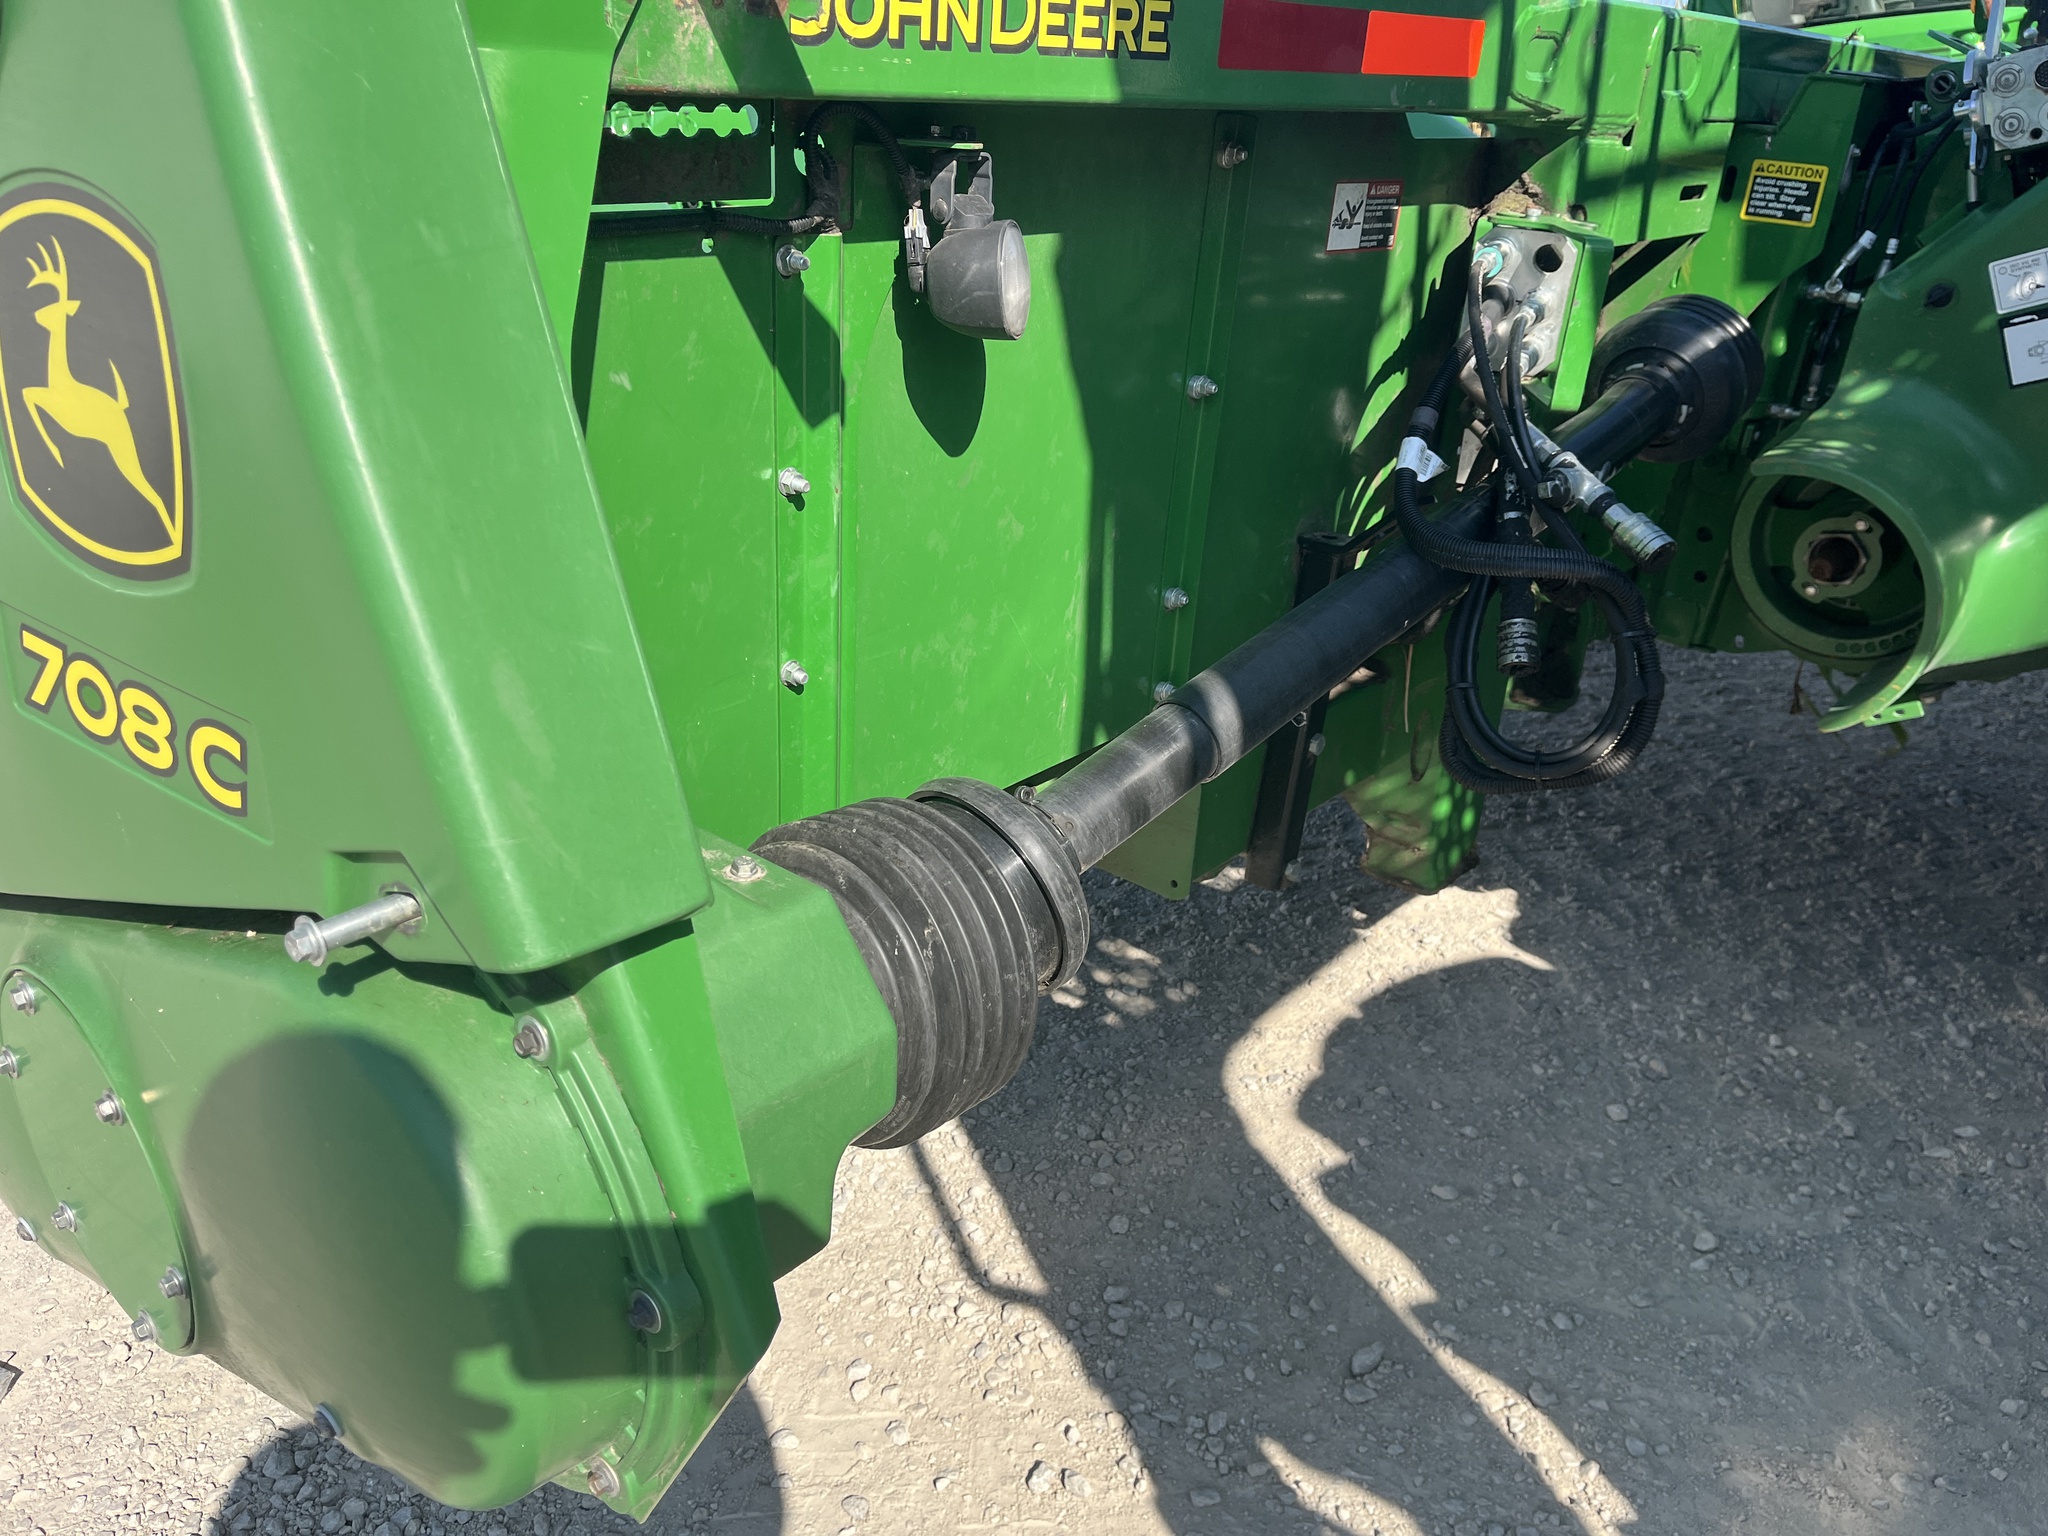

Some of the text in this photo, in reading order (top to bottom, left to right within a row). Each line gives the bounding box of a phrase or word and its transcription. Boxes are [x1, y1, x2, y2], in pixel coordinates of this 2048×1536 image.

[790, 0, 1172, 59] JOHN DEERE
[1766, 163, 1824, 179] CAUTION
[1376, 185, 1400, 195] DANGER
[1755, 177, 1807, 190] Avoid crushing
[1779, 194, 1796, 204] Stay
[1787, 204, 1811, 213] engine
[20, 623, 248, 817] 708 C
